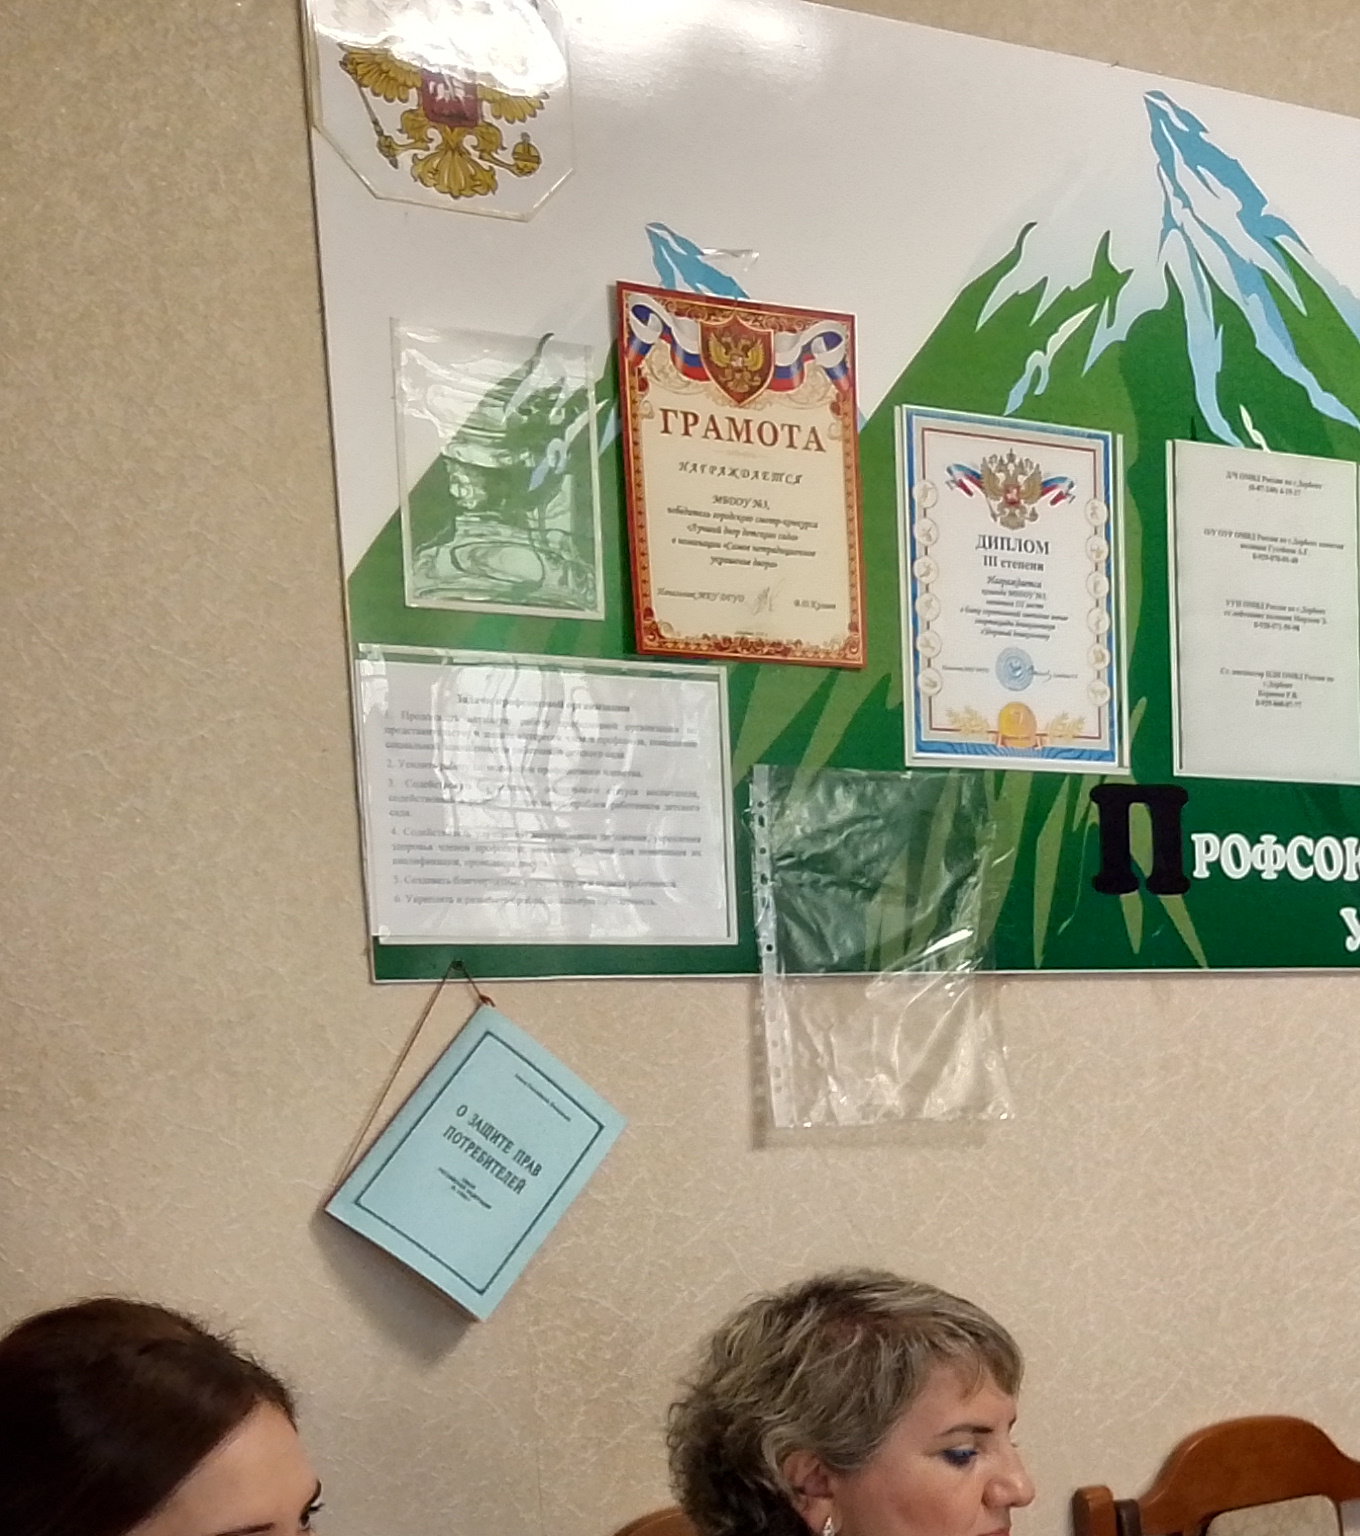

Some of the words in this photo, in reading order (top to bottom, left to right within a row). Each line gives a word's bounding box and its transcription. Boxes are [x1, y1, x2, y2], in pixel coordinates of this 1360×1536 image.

[659, 408, 827, 453] ГРАМОТА
[678, 460, 804, 485] НАГРАЖДАЕТСЯ
[975, 534, 1049, 555] ДИПЛОМ
[983, 555, 997, 567] III
[1001, 560, 1044, 571] степени
[456, 1104, 468, 1117] О
[467, 1113, 515, 1154] ЗАЩИТЕ
[513, 1149, 542, 1177] ПРАВ
[443, 1125, 526, 1195] ПОТРЕБИТЕЛЕЙ
